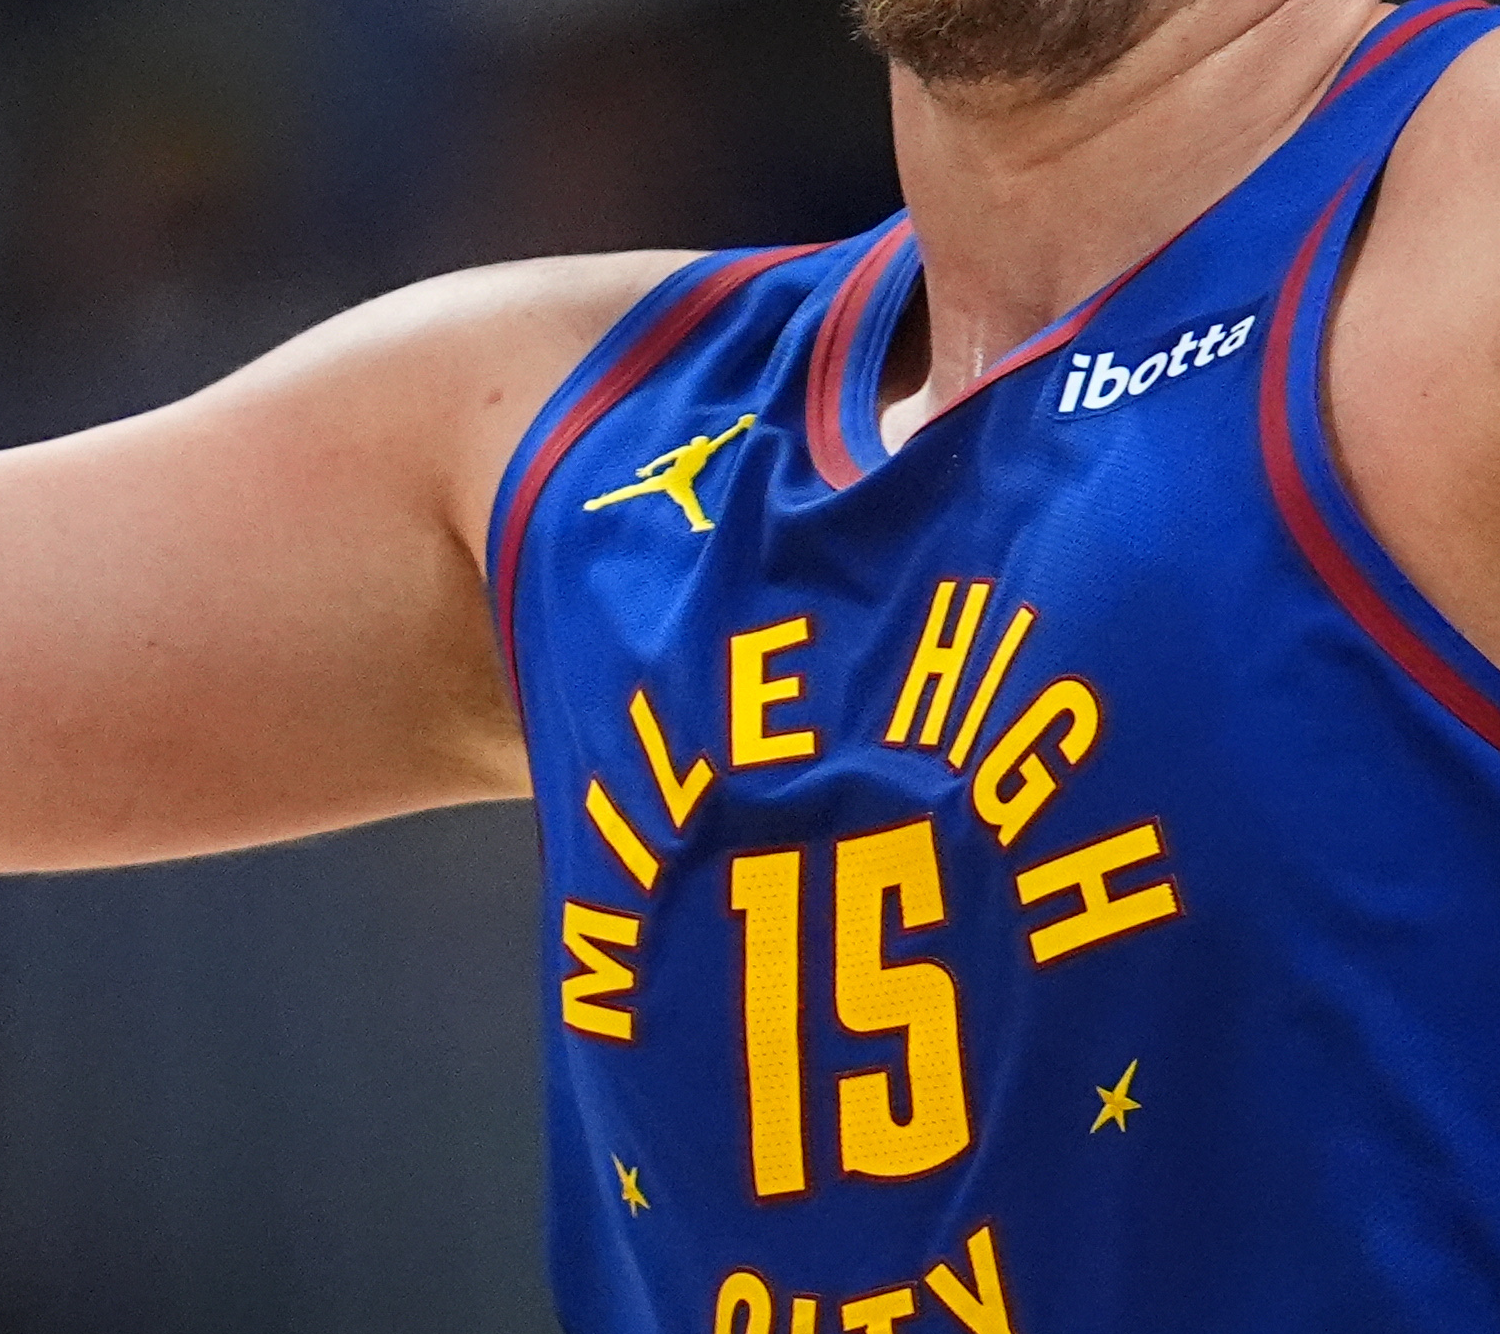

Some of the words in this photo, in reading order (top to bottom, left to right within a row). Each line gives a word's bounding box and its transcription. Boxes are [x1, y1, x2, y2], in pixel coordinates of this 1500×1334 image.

[1058, 314, 1256, 413] ibotta
[559, 616, 818, 1043] MILE
[884, 578, 1182, 966] HIGH
[728, 813, 972, 1200] 15
